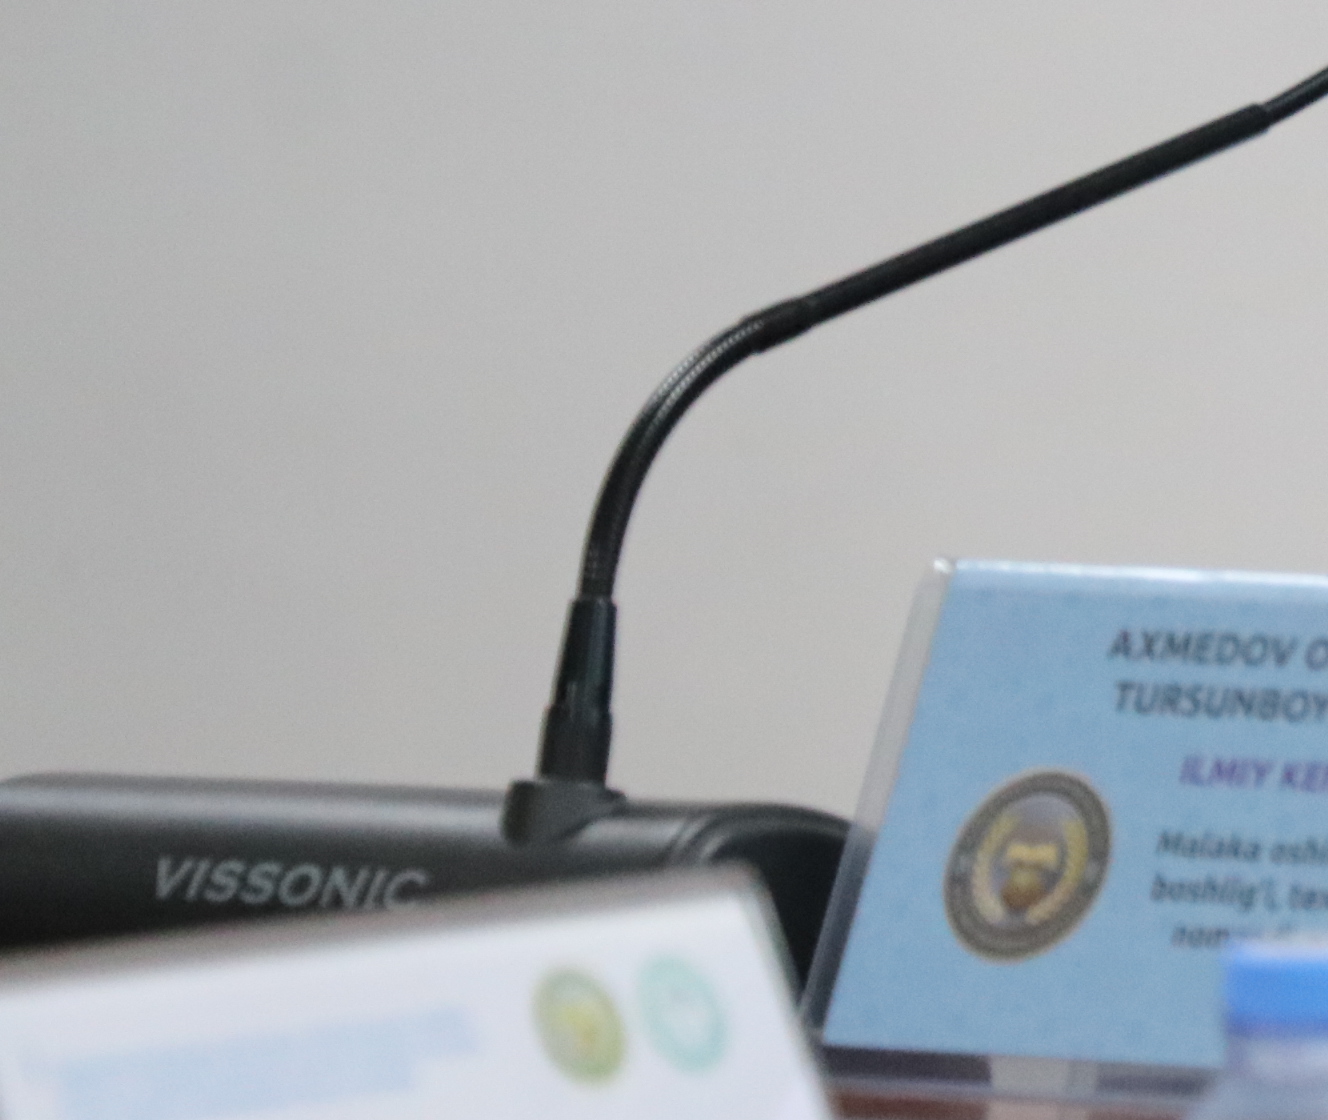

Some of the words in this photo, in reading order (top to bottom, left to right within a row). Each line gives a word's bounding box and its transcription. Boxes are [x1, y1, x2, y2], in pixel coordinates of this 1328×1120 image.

[1108, 630, 1298, 669] AXMEDOV
[1179, 755, 1274, 789] ILMIY
[1157, 830, 1261, 862] Malaka
[155, 855, 429, 911] VISSONIC
